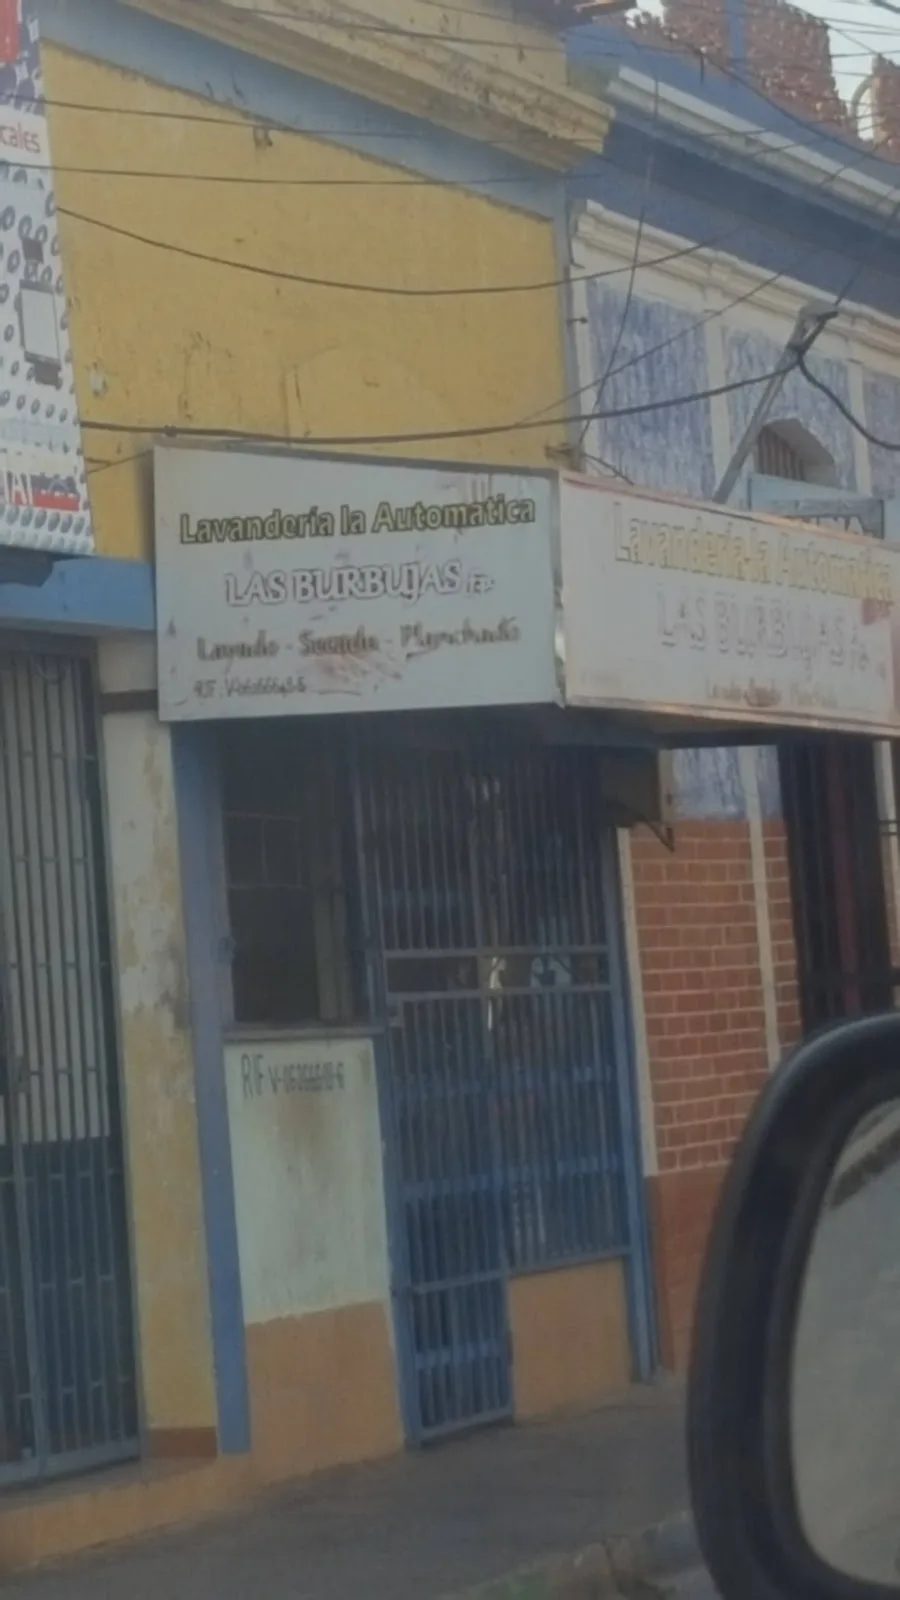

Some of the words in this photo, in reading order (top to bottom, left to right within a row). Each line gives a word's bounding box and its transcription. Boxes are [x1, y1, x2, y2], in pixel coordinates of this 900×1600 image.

[180, 506, 333, 544] Lavandería
[341, 505, 365, 535] la
[225, 570, 287, 607] LAS
[292, 560, 461, 602] BURBUJAS
